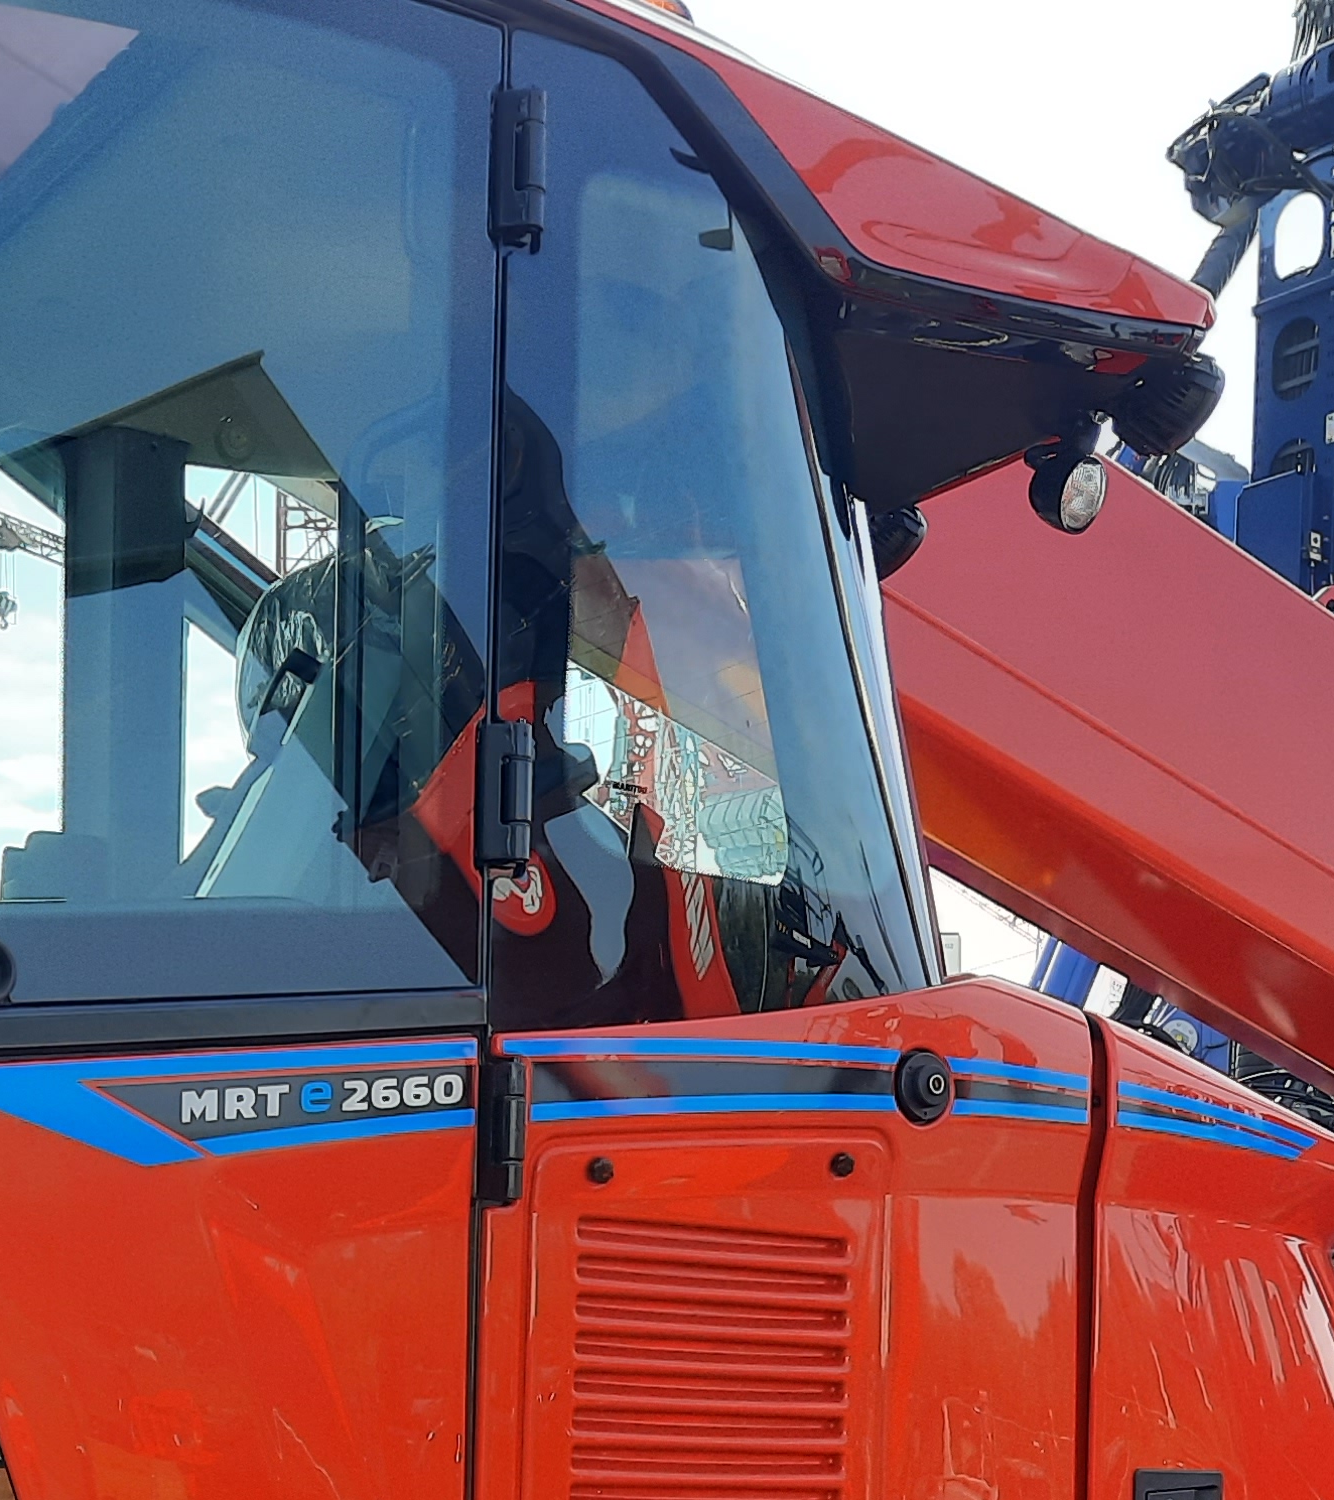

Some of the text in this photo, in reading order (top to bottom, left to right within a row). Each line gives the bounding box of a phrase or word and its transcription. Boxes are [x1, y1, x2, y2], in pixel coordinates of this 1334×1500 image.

[180, 1073, 465, 1123] MRT e 2660
